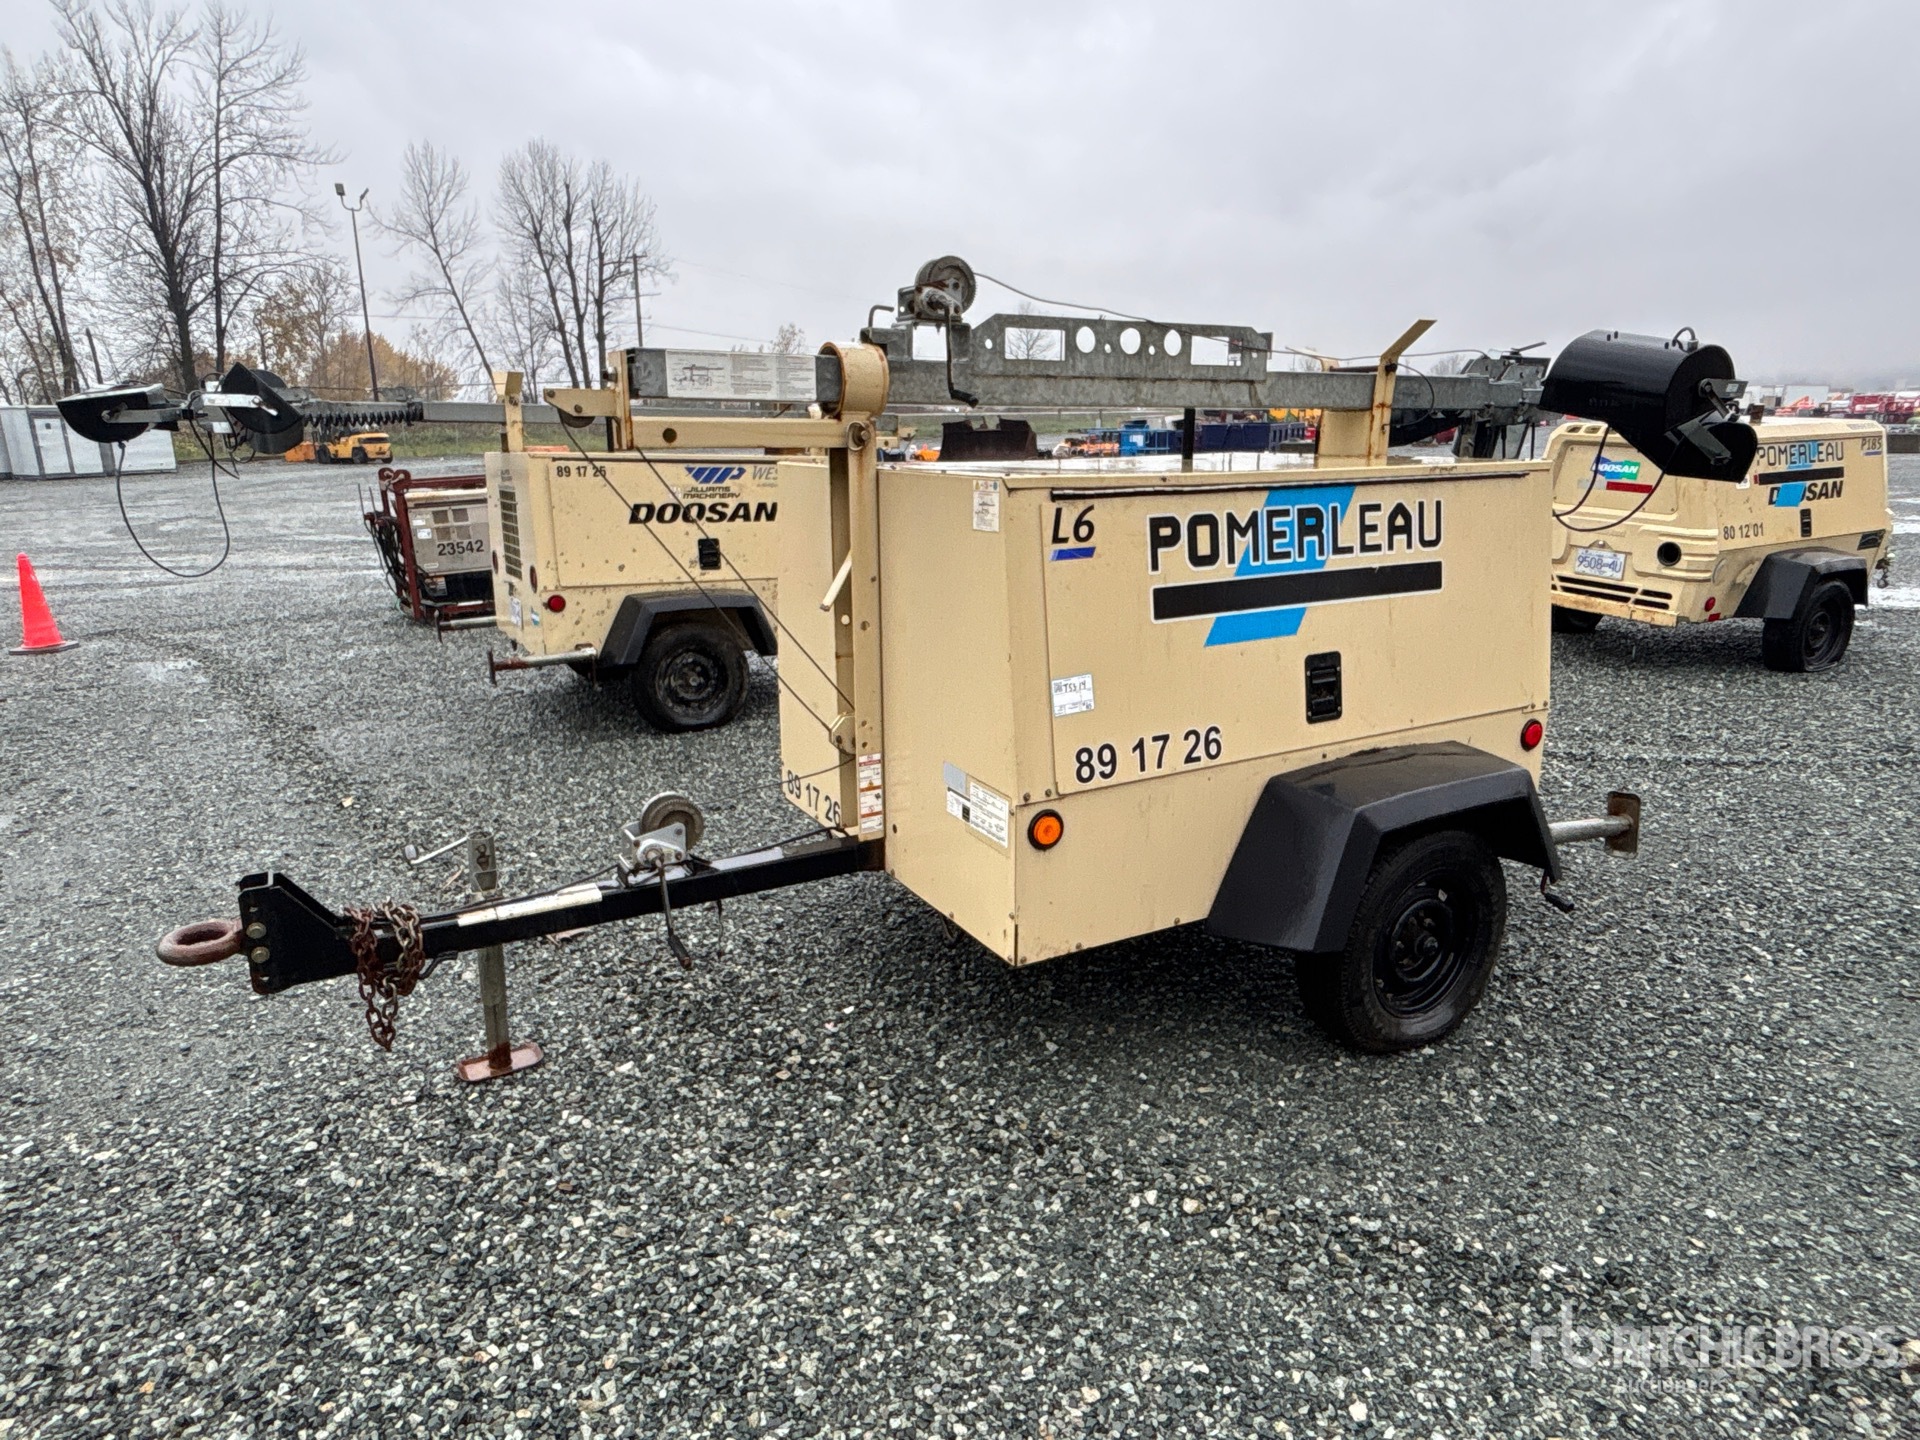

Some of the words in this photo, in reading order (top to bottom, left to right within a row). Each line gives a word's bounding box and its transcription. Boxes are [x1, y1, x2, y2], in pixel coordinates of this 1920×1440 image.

[556, 466, 571, 477] 89
[576, 466, 588, 477] 17
[1767, 481, 1844, 506] DSAN
[629, 501, 778, 525] DOOSAN
[1051, 505, 1096, 545] L6
[1148, 498, 1444, 574] POMERLEAU
[1723, 526, 1736, 540] 80
[1738, 524, 1750, 539] 12
[1752, 522, 1765, 537] 01
[437, 539, 485, 557] 23542
[1075, 742, 1117, 784] 89
[1131, 733, 1171, 774] 17
[1183, 724, 1223, 765] 26
[787, 769, 802, 799] 89
[805, 781, 820, 812] 17
[824, 795, 841, 827] 26
